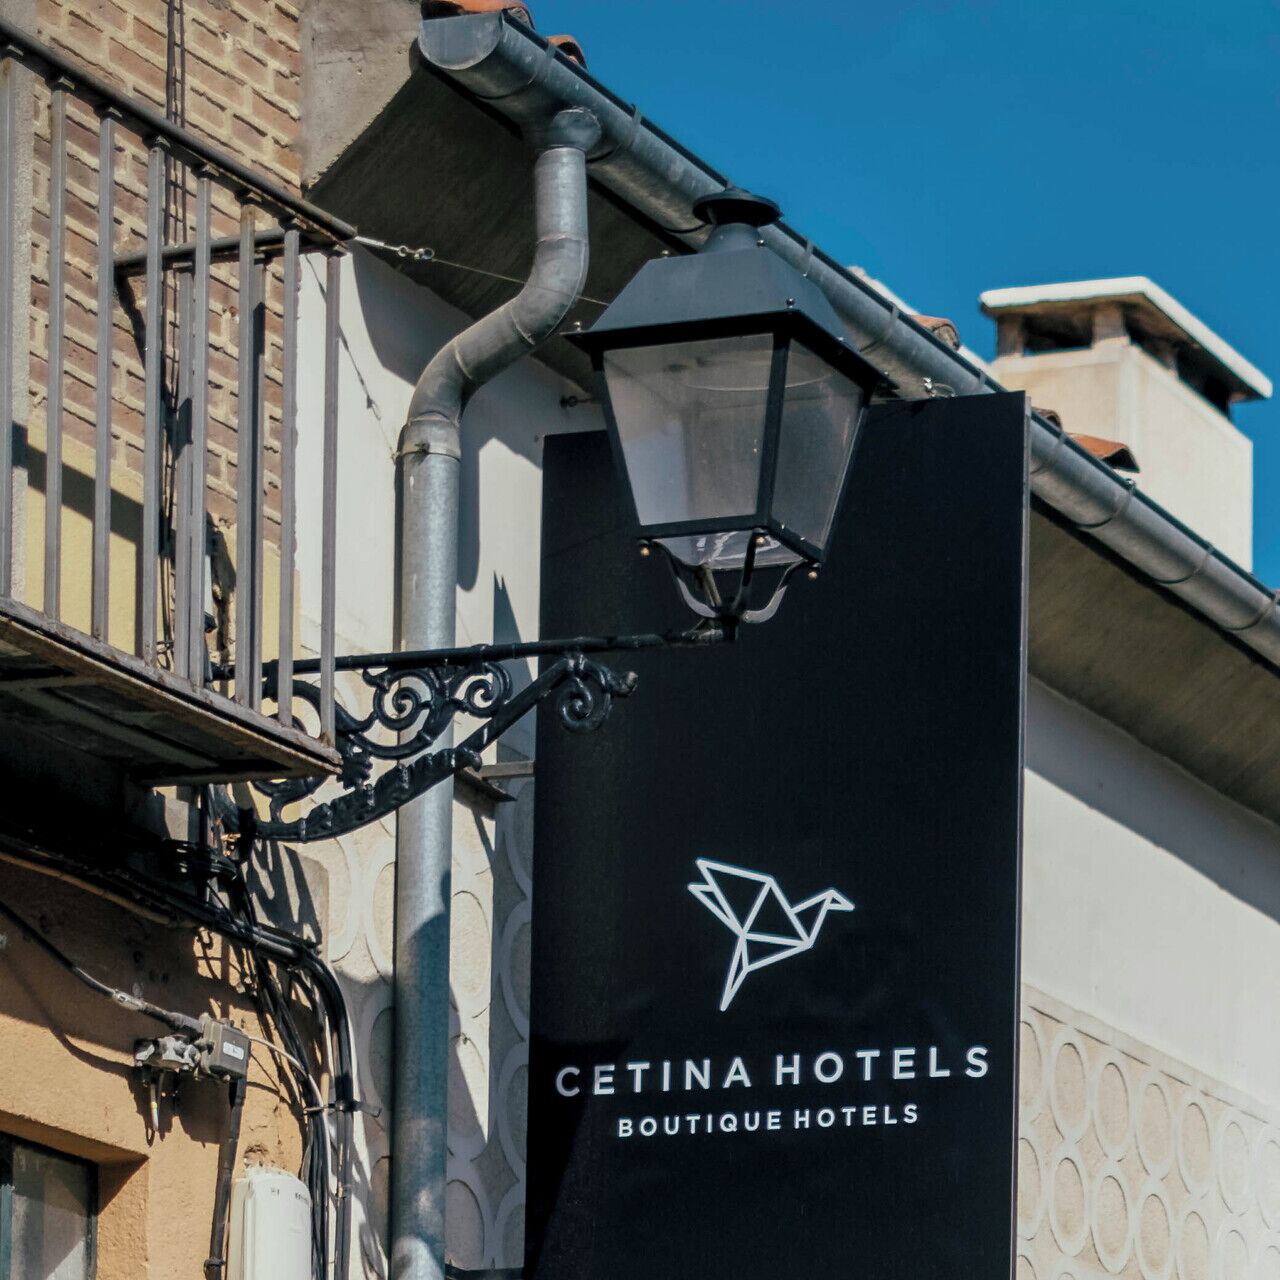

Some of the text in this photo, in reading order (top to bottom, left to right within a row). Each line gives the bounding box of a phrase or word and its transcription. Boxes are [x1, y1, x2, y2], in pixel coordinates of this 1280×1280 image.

[555, 1046, 989, 1098] CETINA HOTELS
[618, 1103, 918, 1138] BOUTIQUE HOTELS
